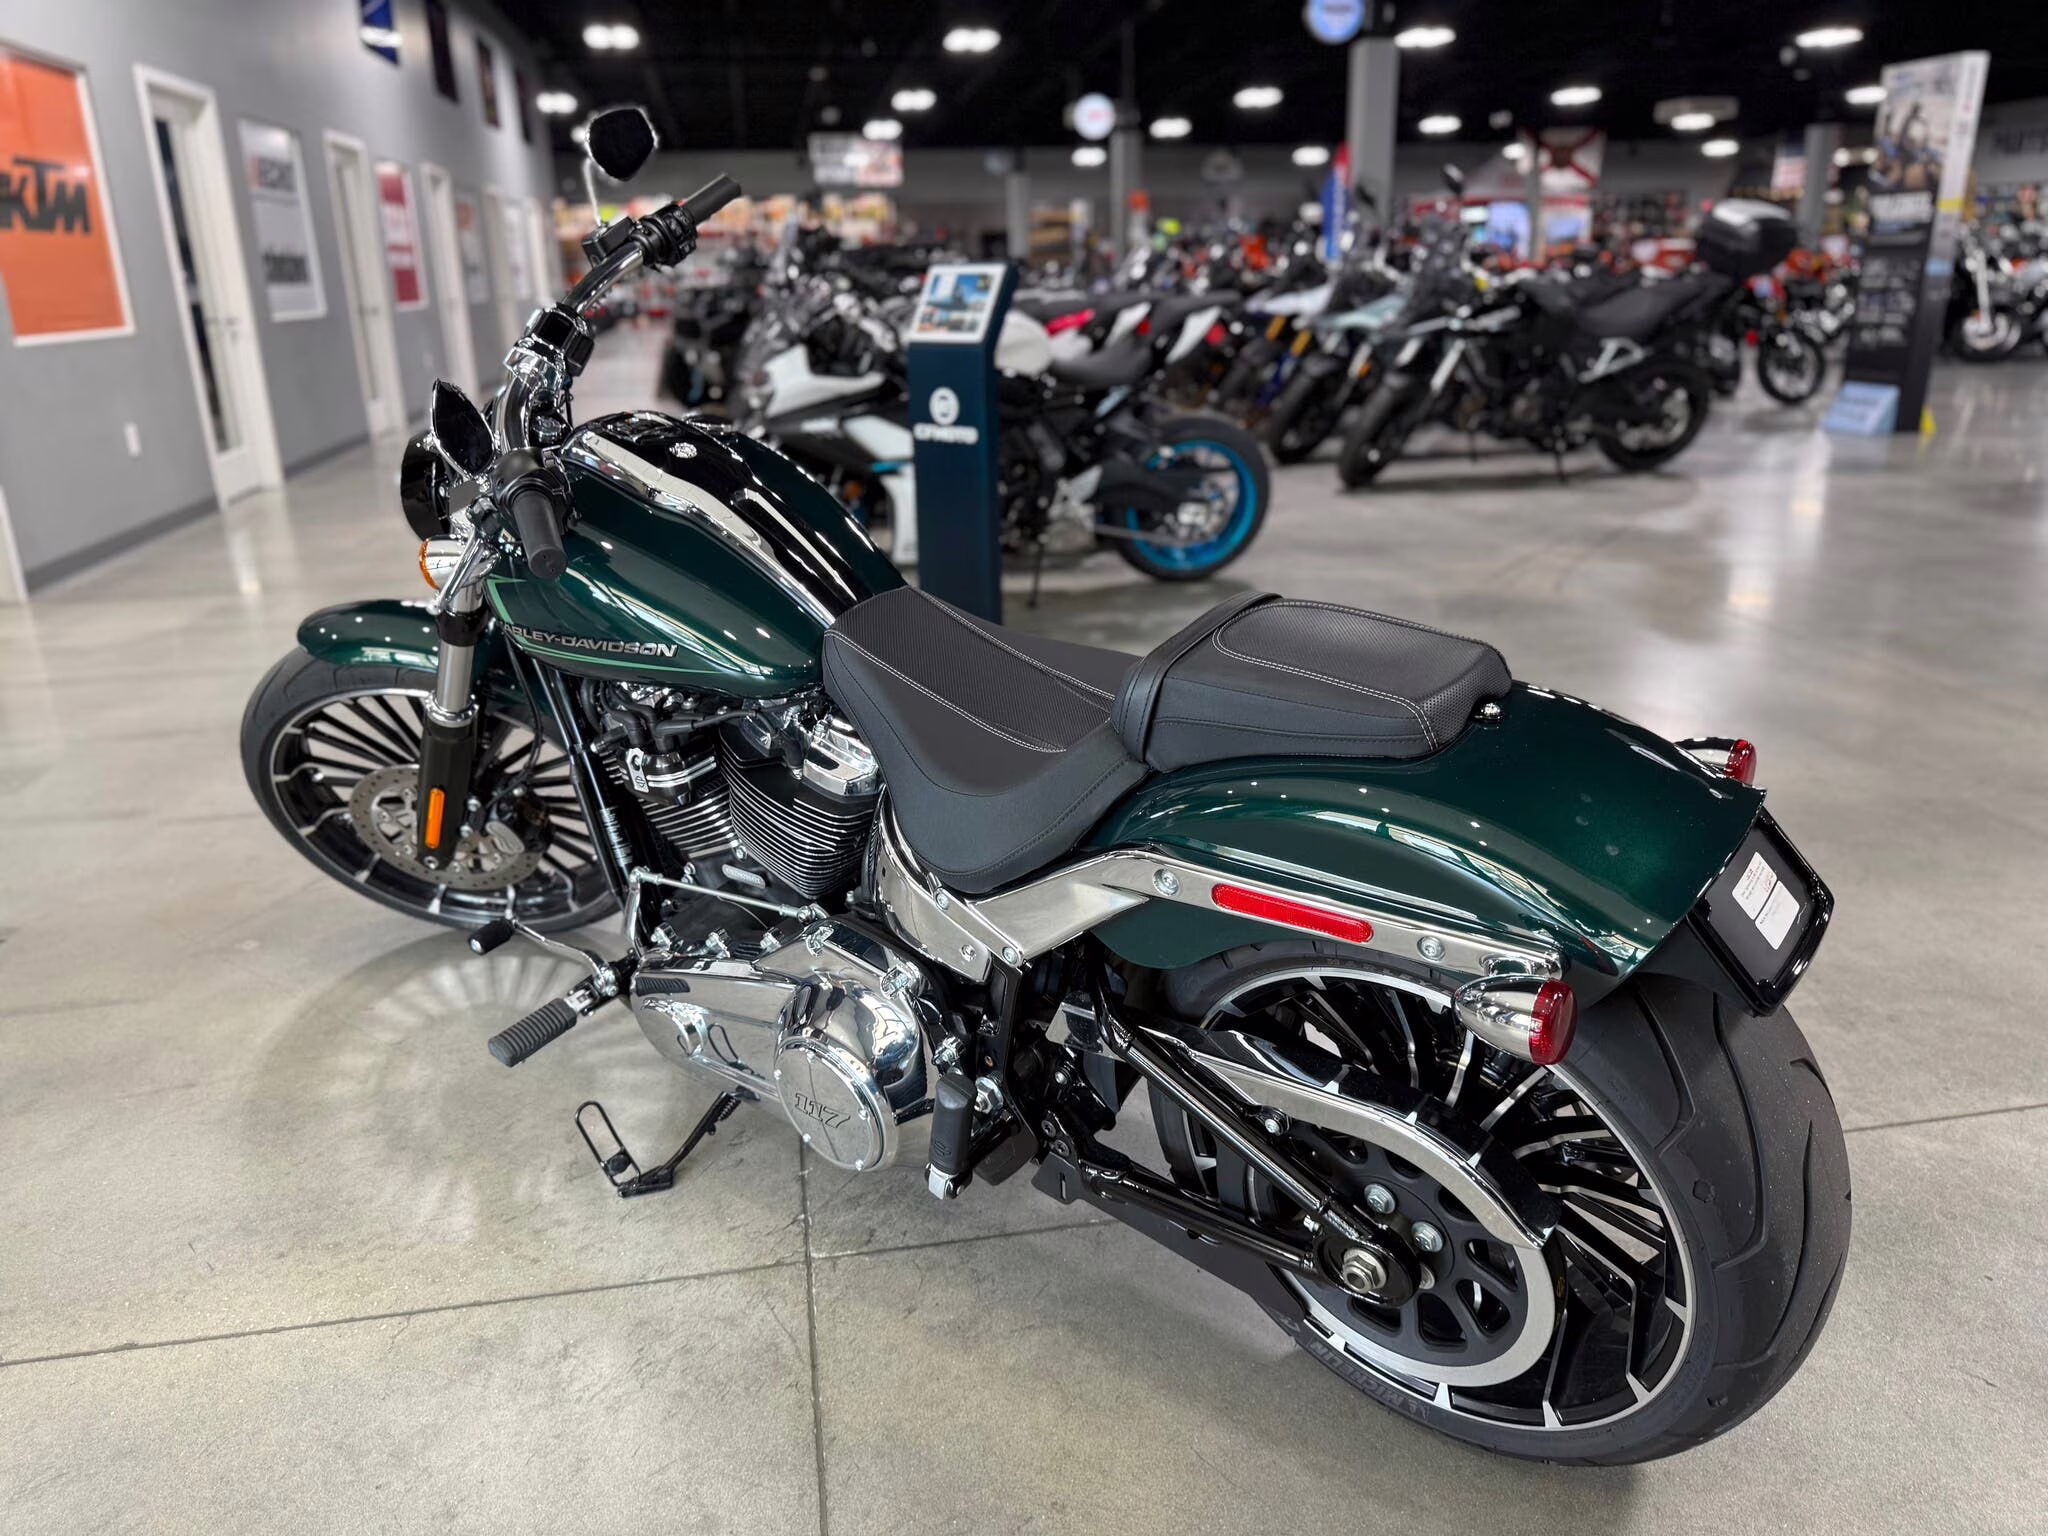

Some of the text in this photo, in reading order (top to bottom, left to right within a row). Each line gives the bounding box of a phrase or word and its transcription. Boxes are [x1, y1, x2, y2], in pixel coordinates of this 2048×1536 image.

[0, 156, 92, 234] KTM
[500, 621, 678, 658] ARLEY-DAVIDSON
[795, 1092, 851, 1129] 117
[1309, 1340, 1403, 1407] MICHELIN
